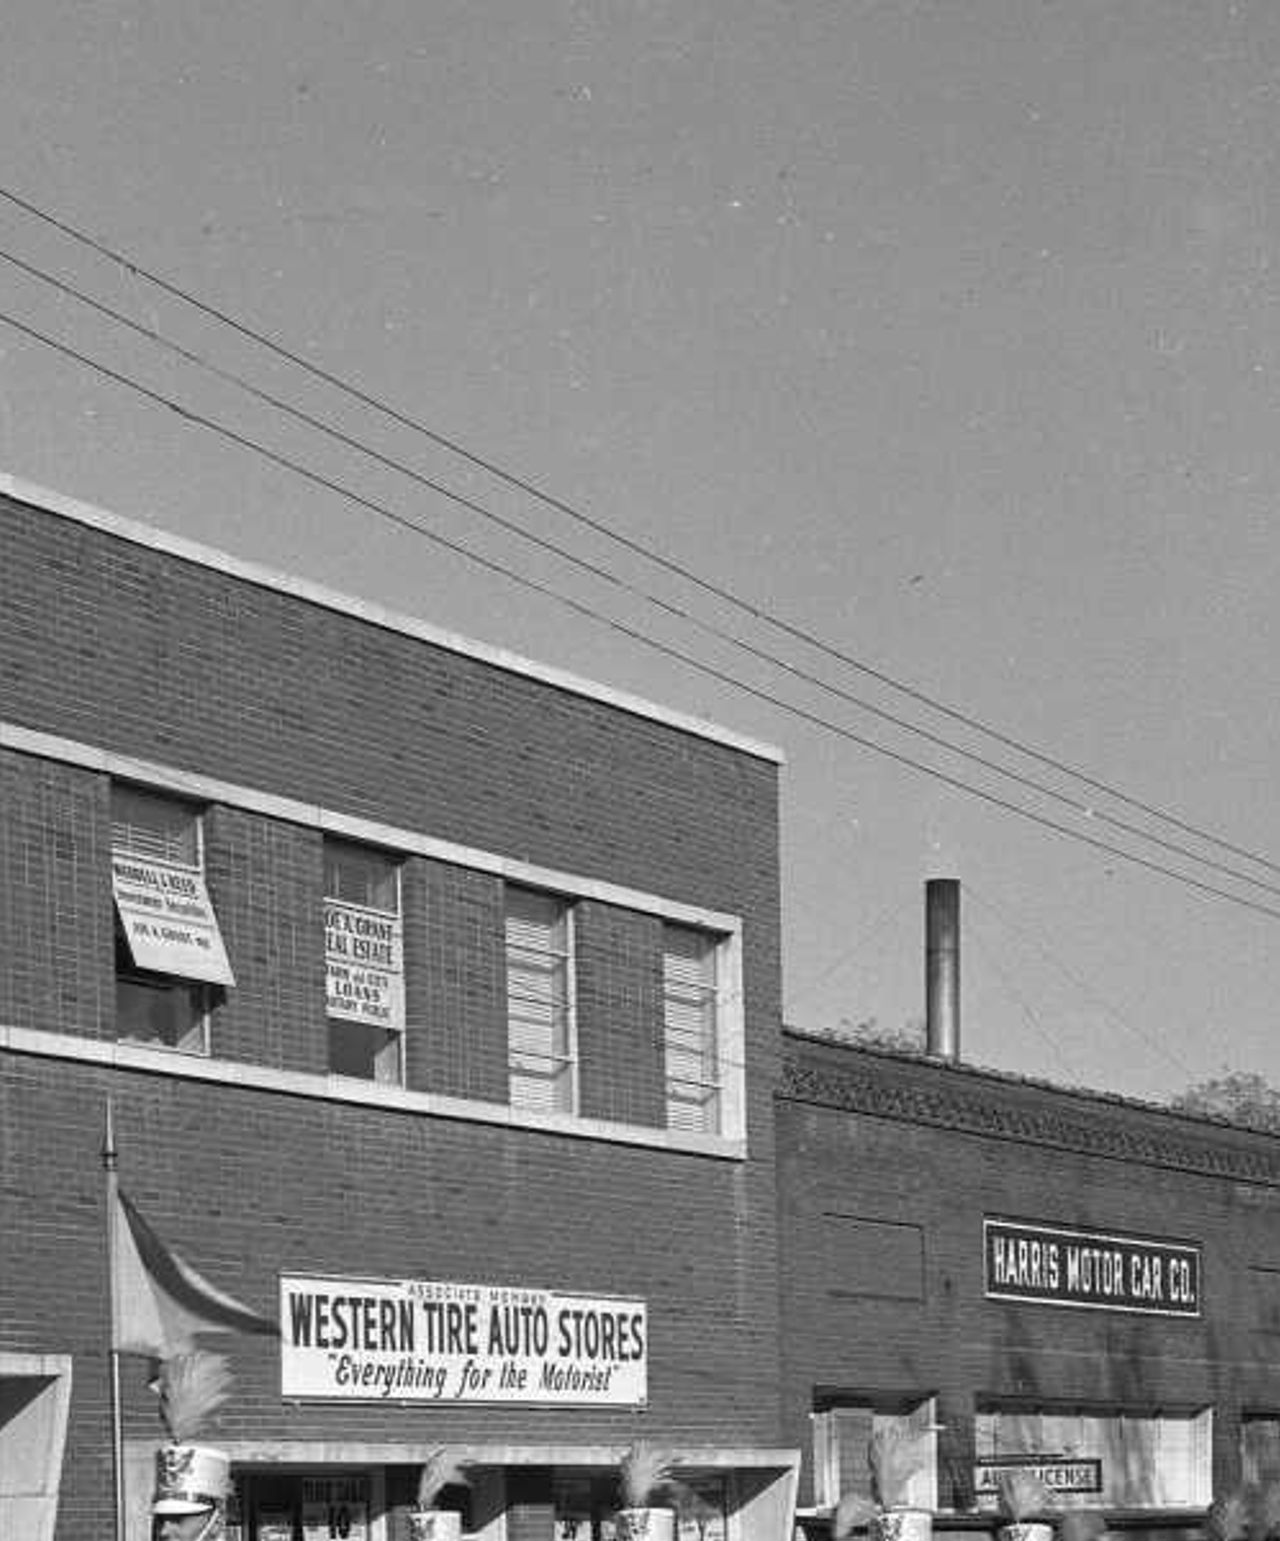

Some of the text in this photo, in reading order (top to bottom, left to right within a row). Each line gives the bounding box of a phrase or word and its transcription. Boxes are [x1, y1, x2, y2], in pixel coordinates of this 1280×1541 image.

[335, 980, 380, 1003] LOANS
[993, 1237, 1196, 1304] HARRIS MOTOR CAR CO.
[289, 1292, 644, 1361] WESTERN TIRE AUTO STORES
[454, 1358, 493, 1398] for
[499, 1359, 528, 1389] the
